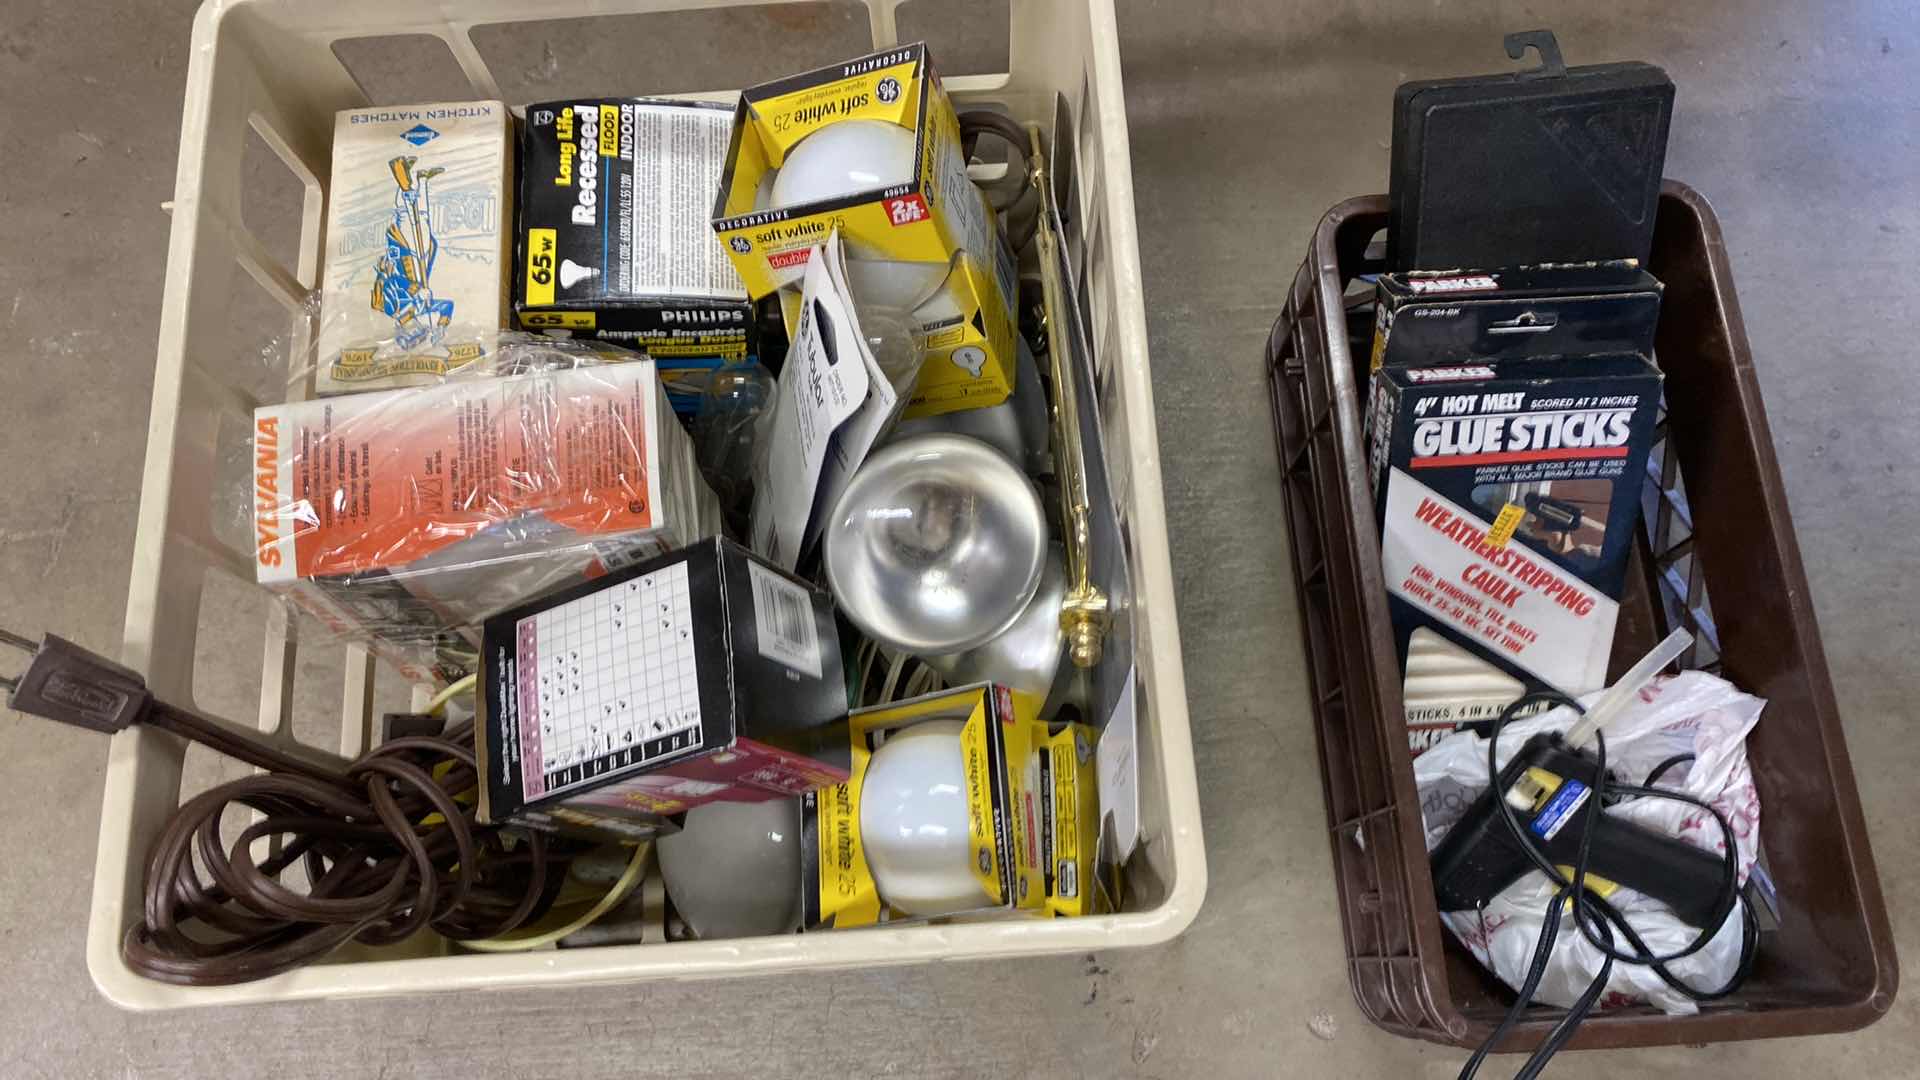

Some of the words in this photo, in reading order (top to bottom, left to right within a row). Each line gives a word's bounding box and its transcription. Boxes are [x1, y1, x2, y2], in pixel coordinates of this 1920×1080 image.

[844, 51, 911, 77] DECORATIVE
[426, 106, 491, 120] KITCHEN
[794, 101, 836, 124] white
[841, 93, 869, 116] soft
[351, 109, 421, 125] MATCHES
[555, 106, 577, 139] Life
[774, 112, 791, 133] 25
[603, 109, 617, 154] FLOOD
[619, 103, 634, 161] INDOOR
[554, 142, 577, 188] Long
[571, 105, 599, 227] Recessed
[718, 210, 790, 231] DECORATIVE
[756, 230, 782, 245] soft
[784, 221, 825, 241] white
[531, 250, 552, 286] 65
[771, 251, 809, 268] double
[661, 309, 745, 324] PHILIPS
[596, 328, 668, 341] Ampoule
[808, 330, 825, 409] Tubular
[1406, 366, 1498, 383] PARKER
[1441, 395, 1478, 415] HOT
[1481, 391, 1526, 413] MELT
[1530, 398, 1575, 410] SCORED
[1575, 397, 1589, 408] AT
[1590, 397, 1598, 407] 2
[1599, 395, 1640, 407] INCHES
[1412, 419, 1506, 458] GLUE
[1509, 409, 1633, 452] STICKS
[1475, 474, 1496, 484] WITH
[1497, 473, 1512, 482] ALL
[1514, 471, 1542, 481] MAJOR
[1544, 469, 1574, 479] BRAND
[1575, 468, 1598, 477] GLUE
[1511, 464, 1533, 473] GLUE
[1536, 463, 1565, 472] STICKS
[1567, 461, 1586, 470] CAN
[1588, 460, 1601, 468] BE
[1603, 459, 1626, 468] USED
[257, 415, 280, 569] SYLVANIA
[1401, 579, 1433, 603] QUICK
[1460, 562, 1527, 609] CAULK
[967, 746, 982, 801] white
[838, 819, 856, 871] white
